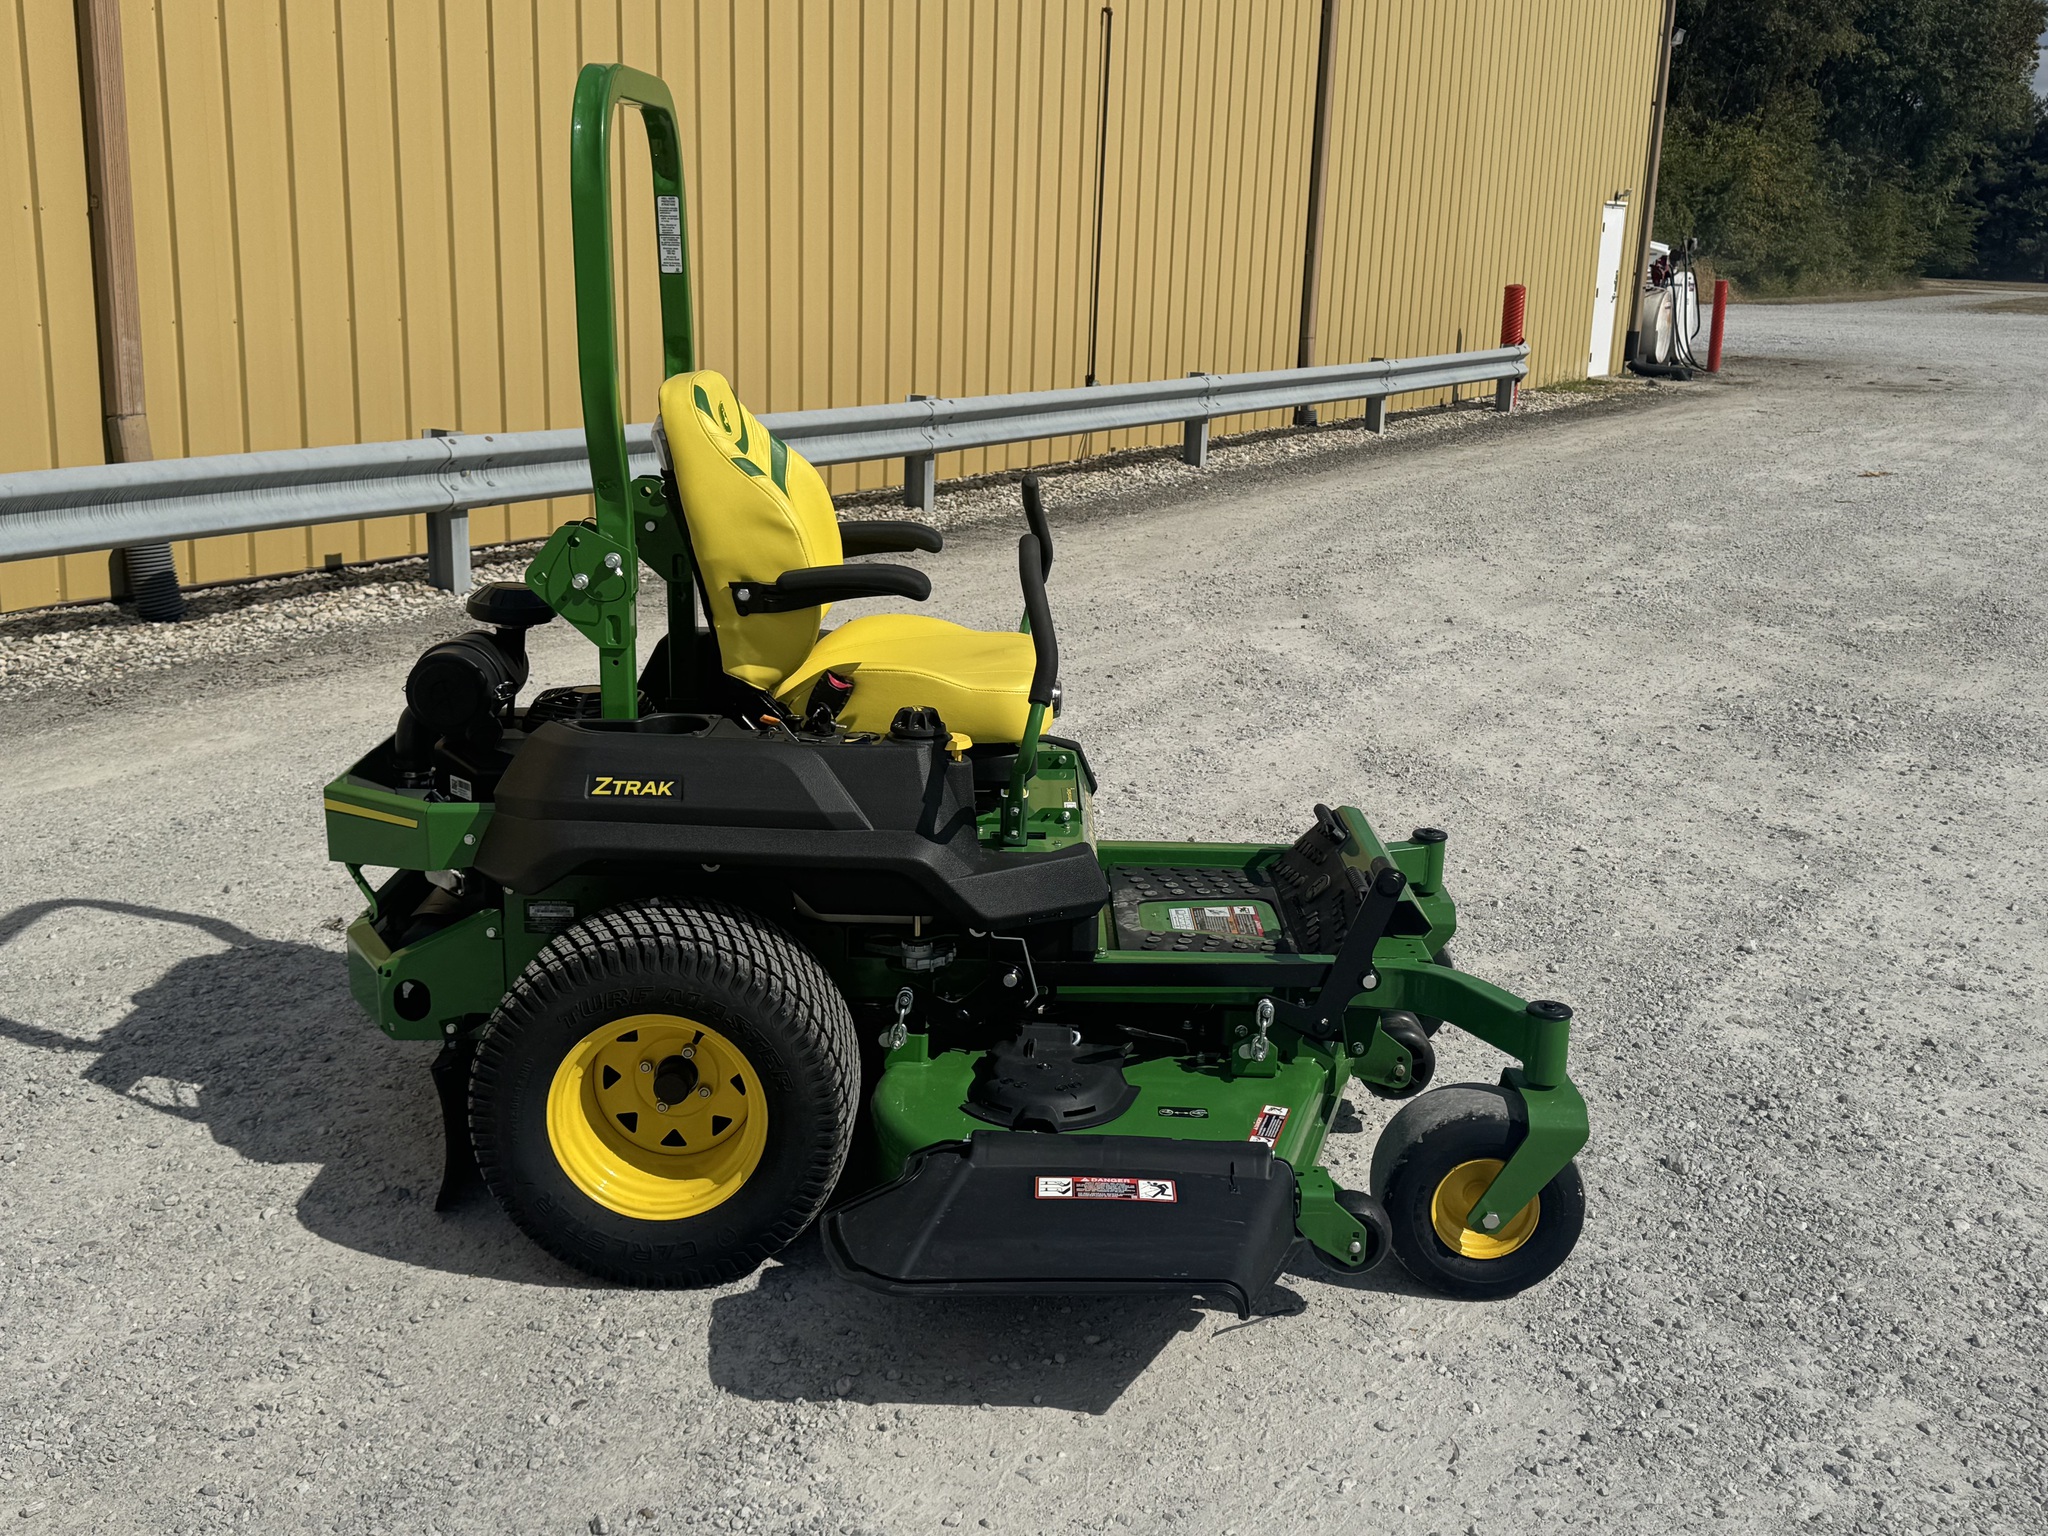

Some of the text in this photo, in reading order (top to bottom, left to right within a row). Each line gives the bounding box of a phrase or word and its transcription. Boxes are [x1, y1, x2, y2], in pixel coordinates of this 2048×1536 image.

[591, 776, 675, 796] ZTRAK
[557, 985, 794, 1092] TURF MASTER
